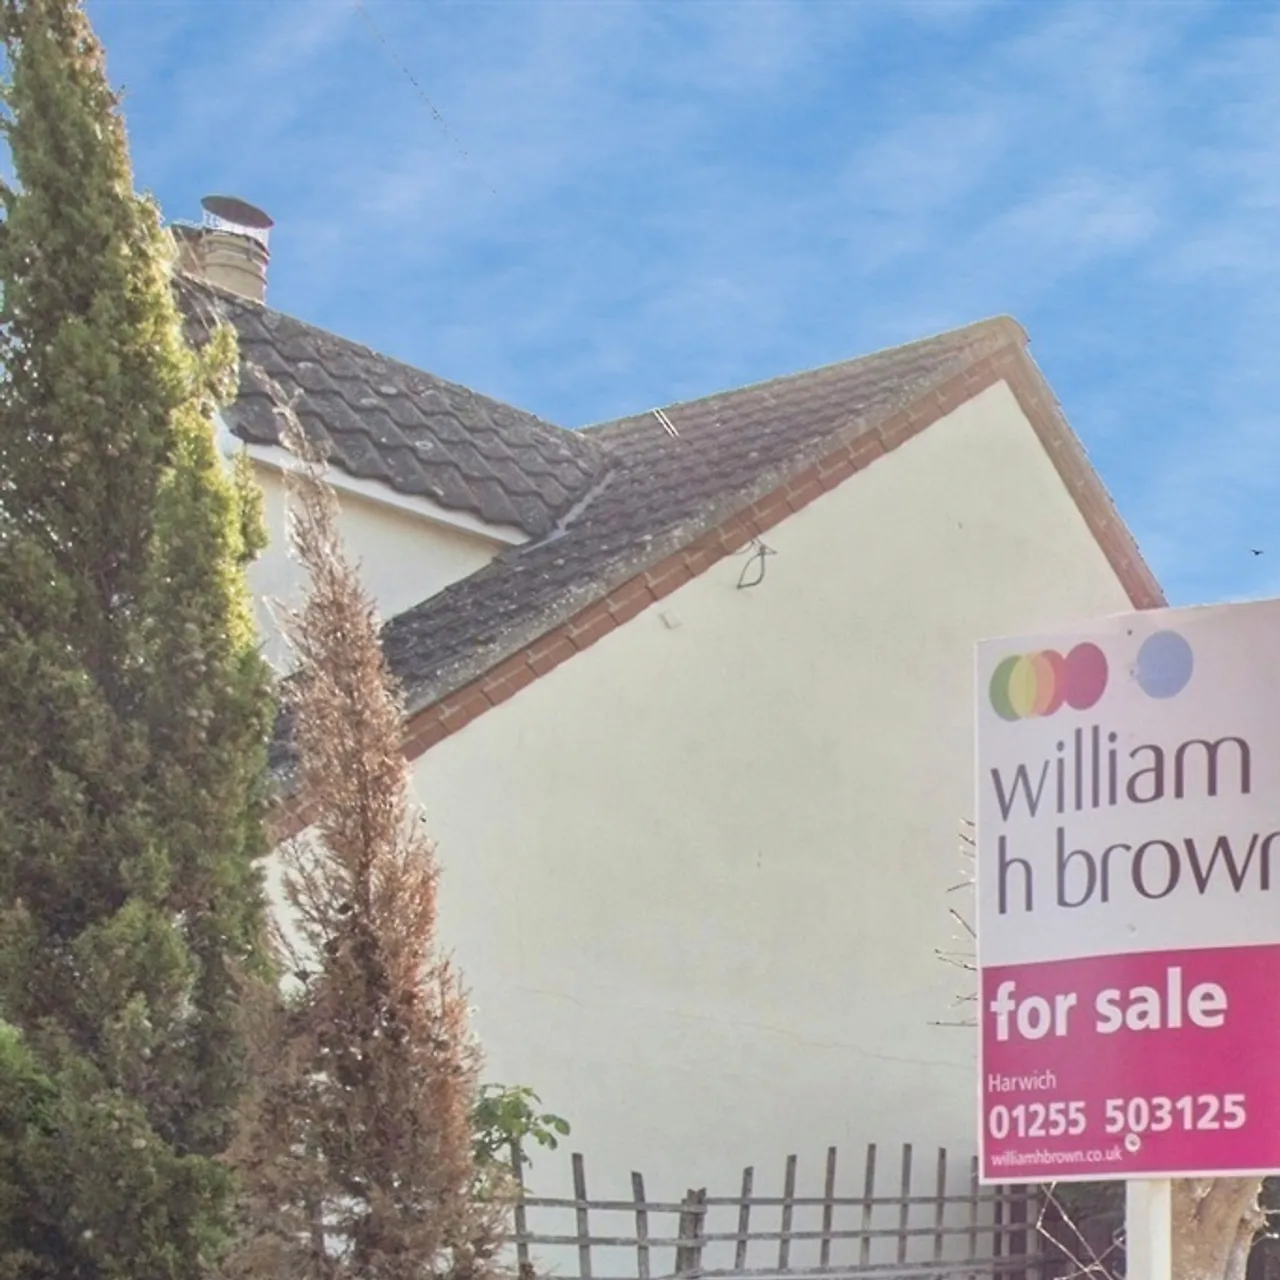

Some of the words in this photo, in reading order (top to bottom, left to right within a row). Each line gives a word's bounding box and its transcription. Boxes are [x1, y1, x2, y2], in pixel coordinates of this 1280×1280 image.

[990, 724, 1251, 823] william
[998, 834, 1033, 915] h
[990, 980, 1077, 1041] for
[1095, 966, 1228, 1034] sale
[988, 1070, 1057, 1093] Harwich
[989, 1101, 1086, 1139] 01255
[1105, 1094, 1246, 1132] 503125
[991, 1145, 1123, 1167] williamhbrown.co.uk
